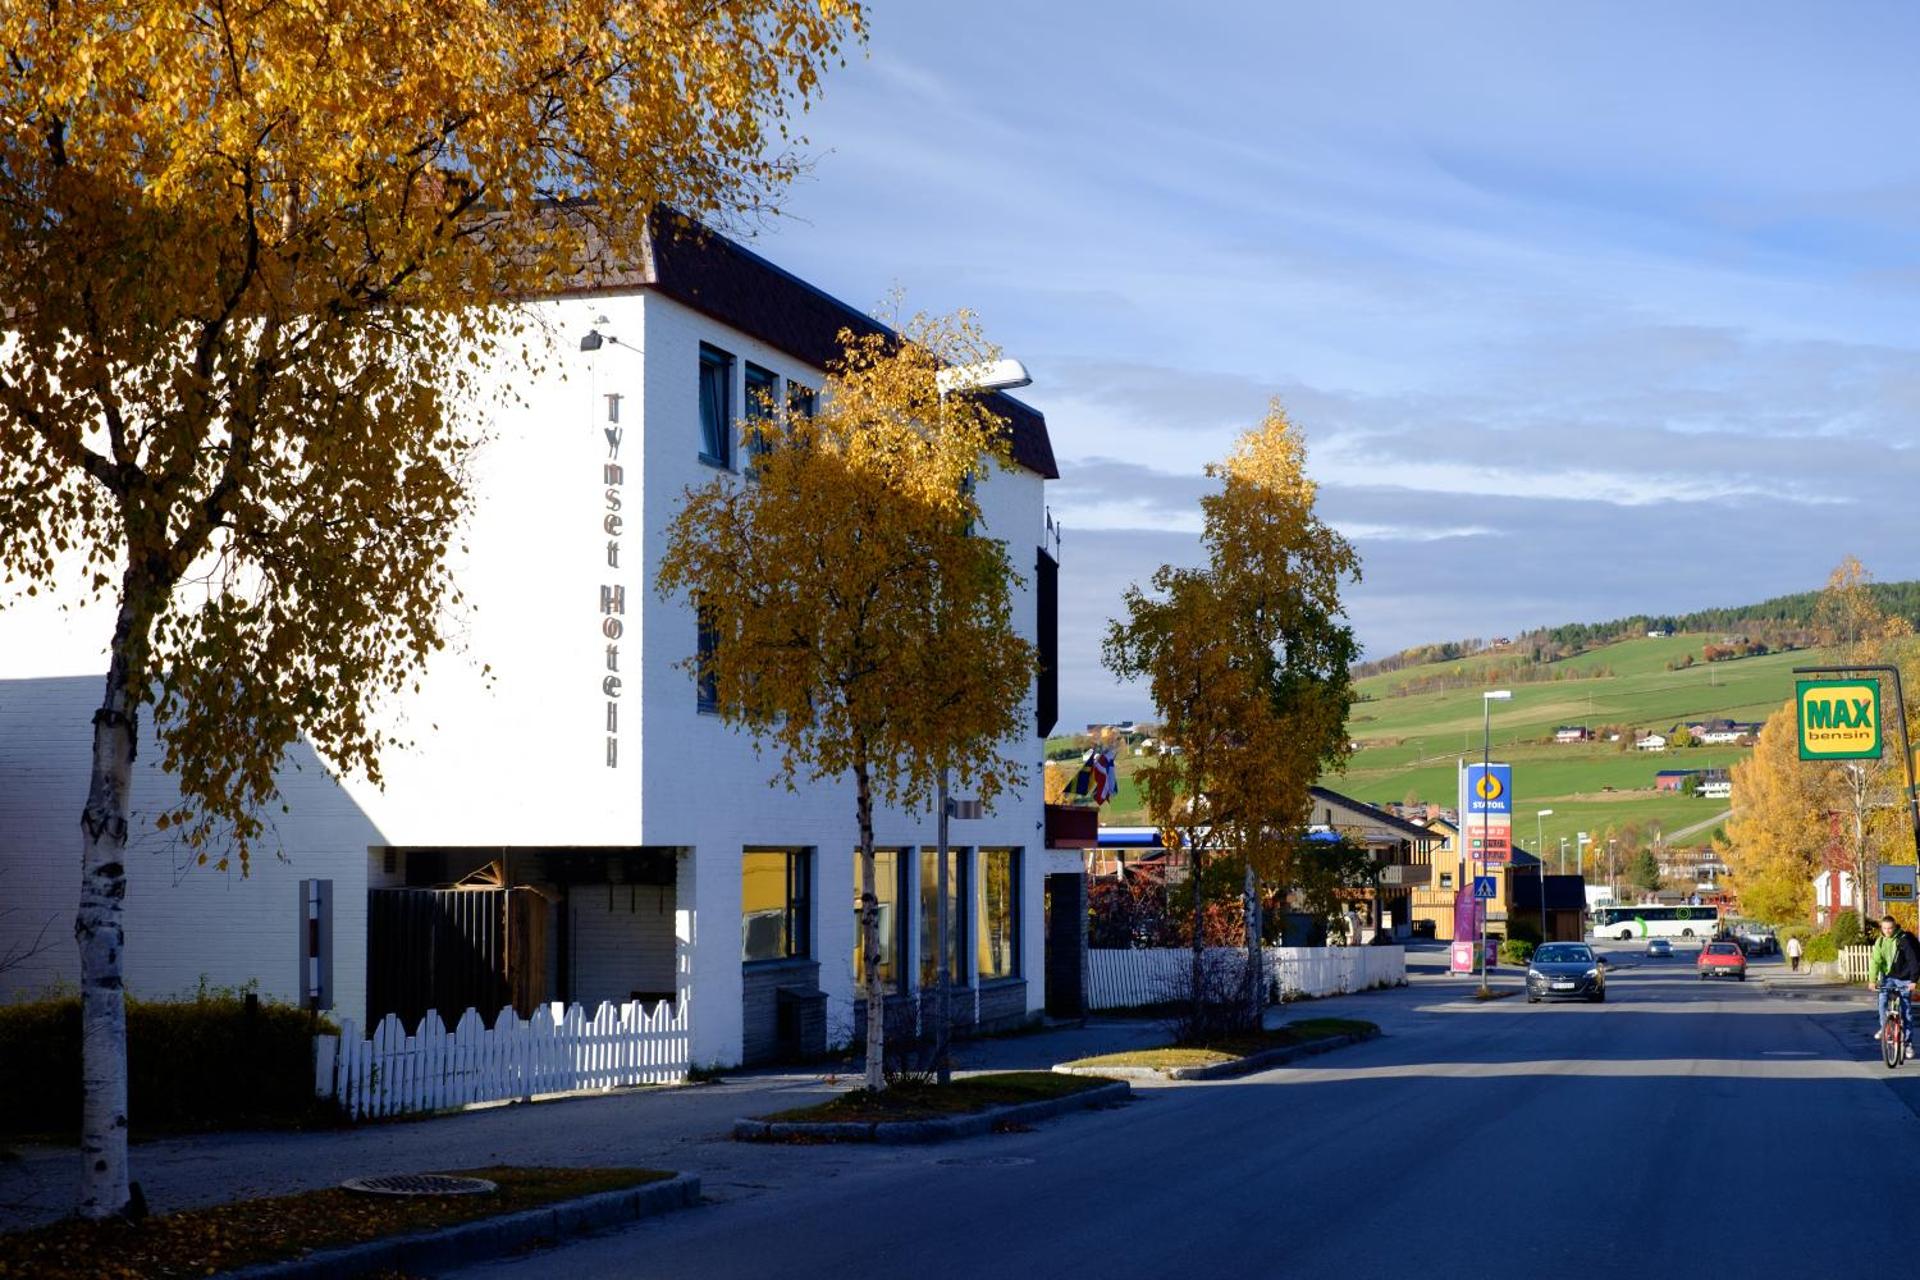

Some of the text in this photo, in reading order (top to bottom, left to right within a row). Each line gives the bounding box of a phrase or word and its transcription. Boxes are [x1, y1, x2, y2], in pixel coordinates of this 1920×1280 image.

[600, 393, 626, 768] Tynset Hotell
[1806, 699, 1872, 729] MAX
[1809, 730, 1870, 741] bensin
